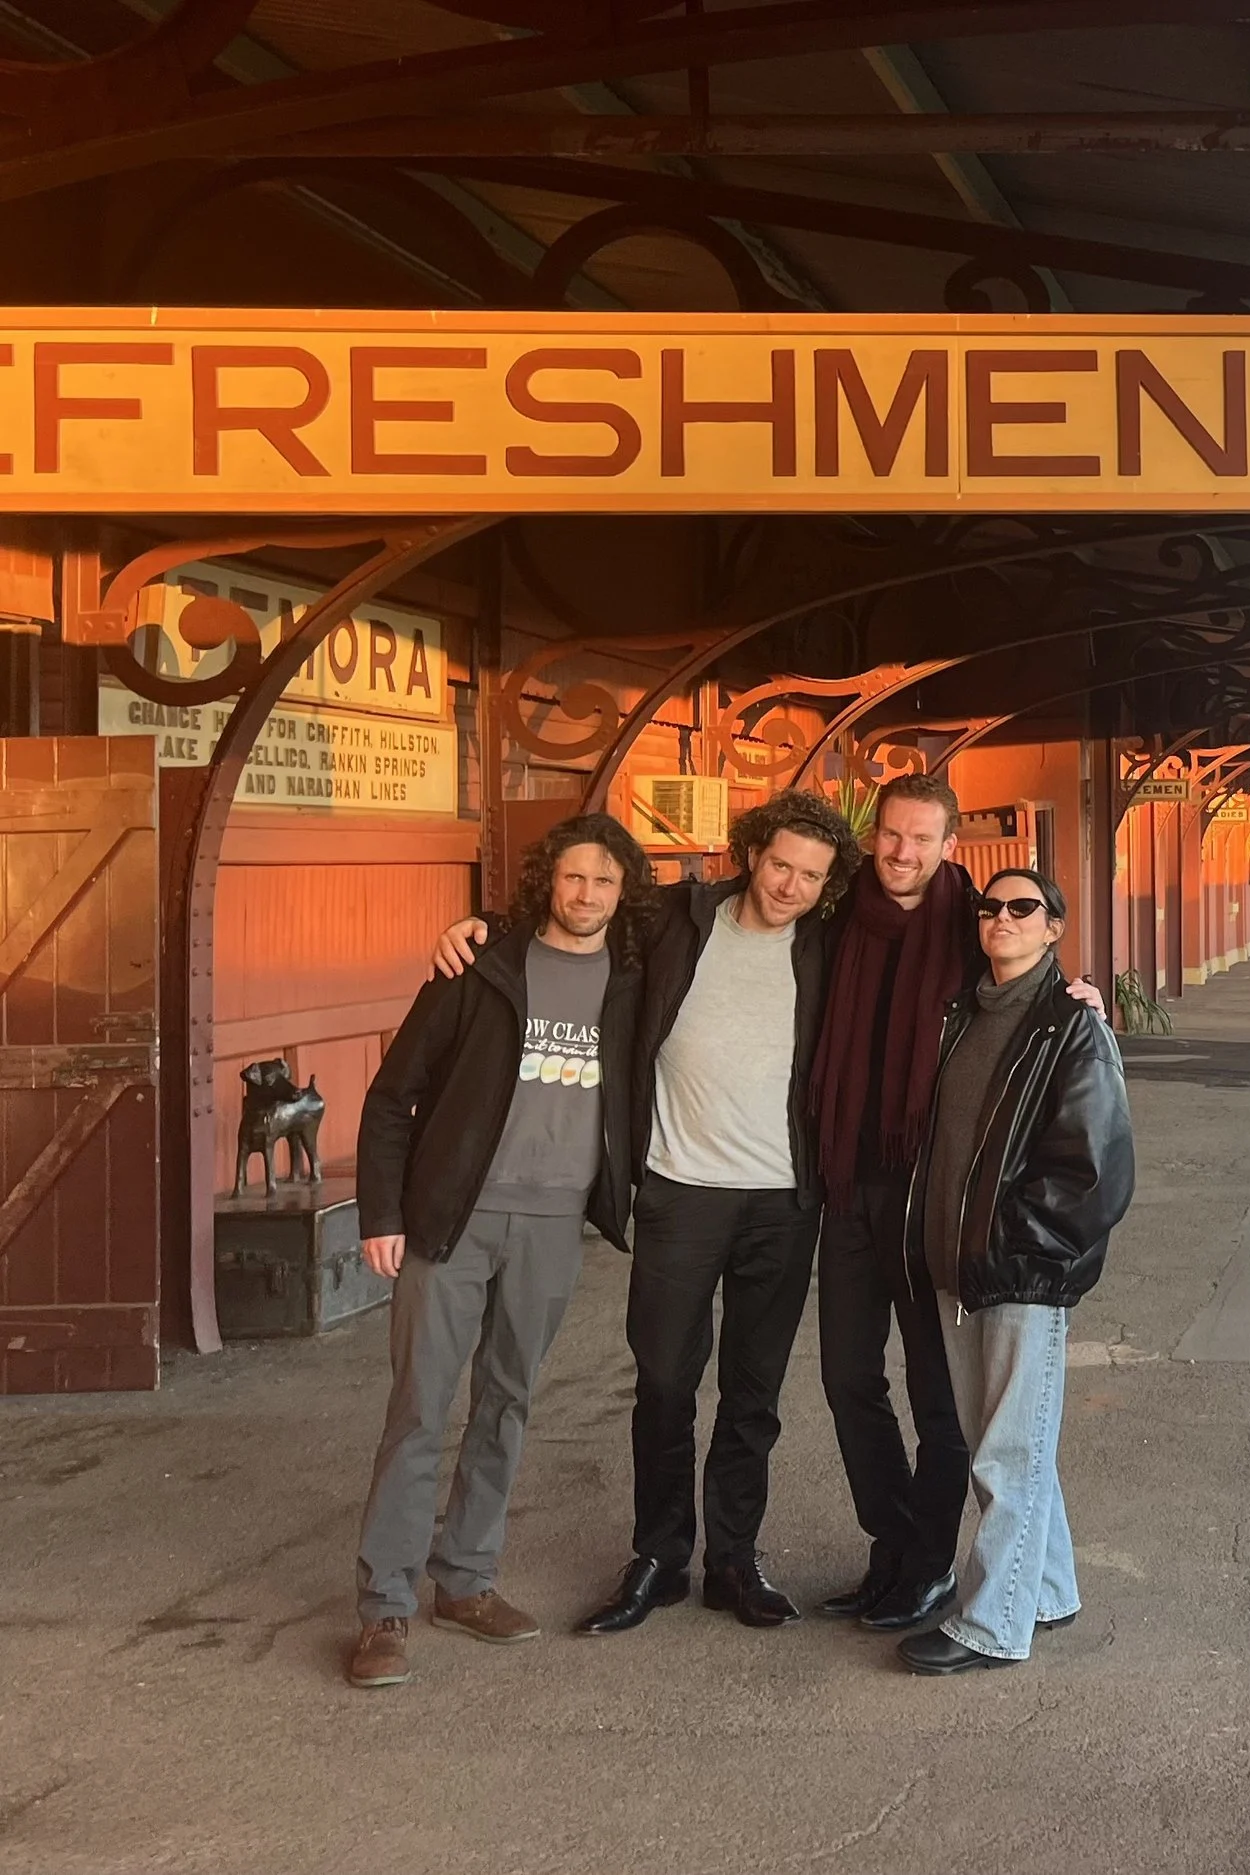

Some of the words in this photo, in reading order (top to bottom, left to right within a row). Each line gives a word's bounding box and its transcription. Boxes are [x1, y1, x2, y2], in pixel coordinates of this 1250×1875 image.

[267, 717, 296, 741] FOR
[159, 735, 198, 761] AKE
[320, 751, 367, 774] RANKIN
[245, 772, 276, 796] AND
[371, 782, 407, 801] LINES
